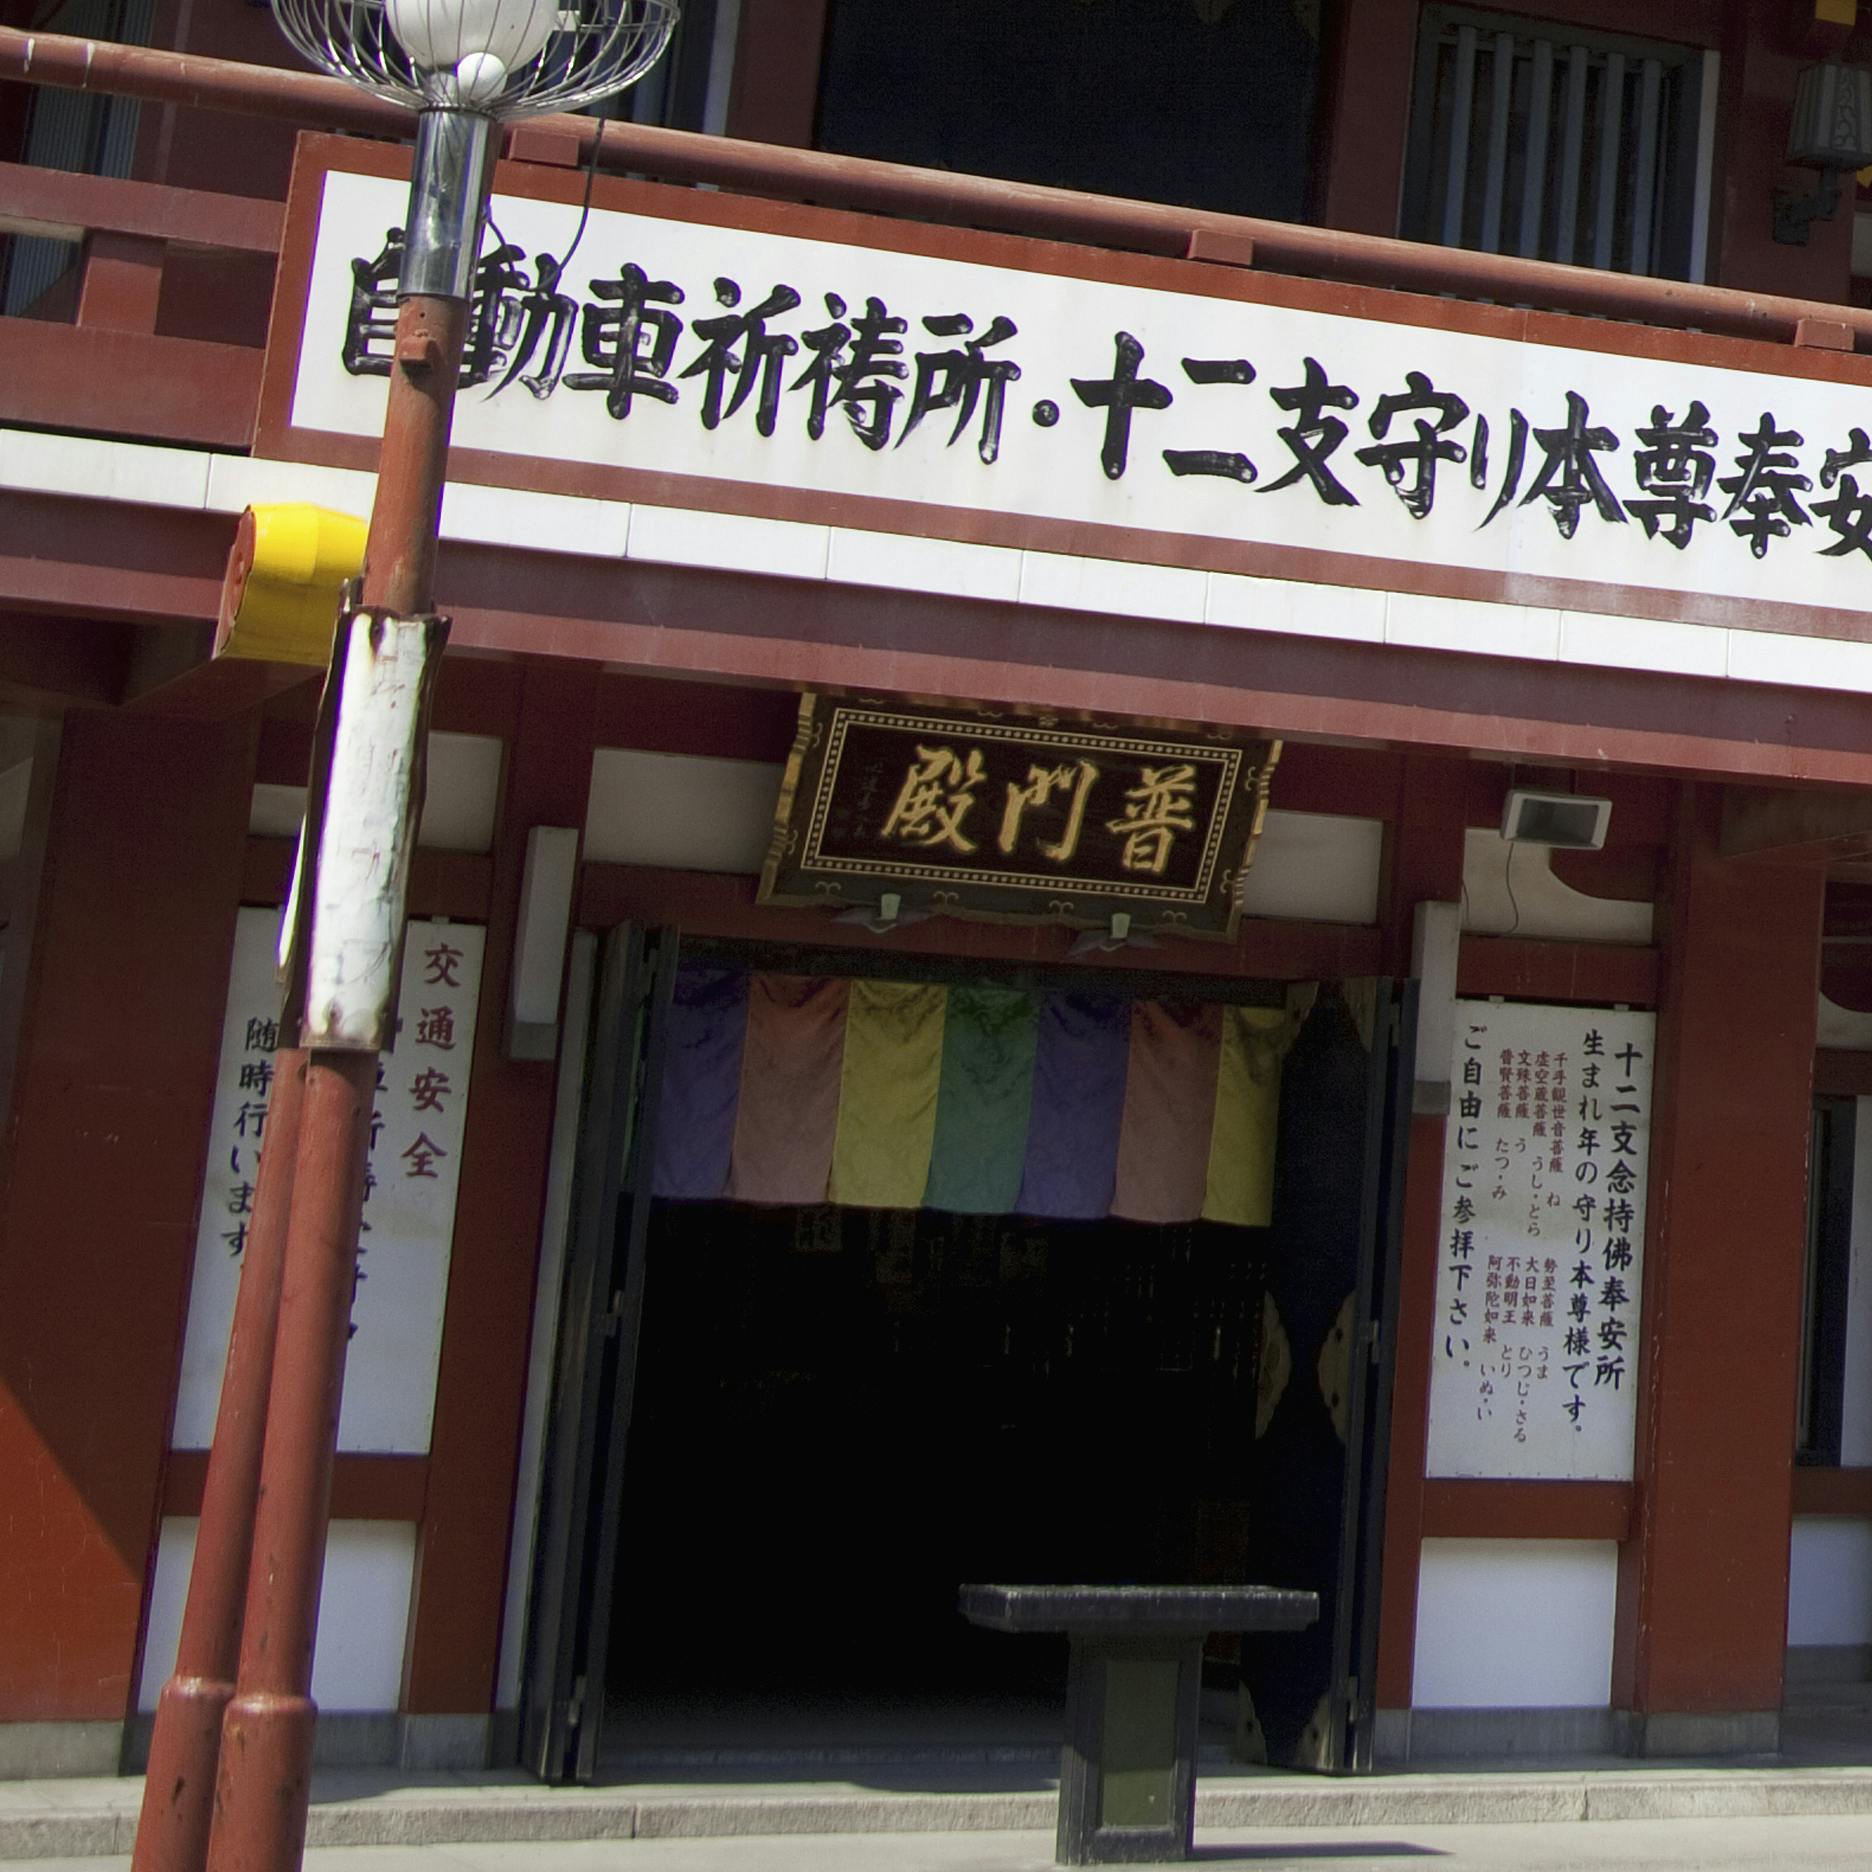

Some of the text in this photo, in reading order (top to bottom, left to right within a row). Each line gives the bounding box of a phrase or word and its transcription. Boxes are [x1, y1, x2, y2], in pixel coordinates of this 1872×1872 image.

[880, 743, 1198, 874] 普門殿
[400, 942, 464, 1179] 交通安全
[1514, 1049, 1532, 1153] 文殊菩薩 う
[1445, 1024, 1488, 1368] ご自由にご参拝下さい。
[1546, 1191, 1561, 1207] ね
[1562, 1028, 1605, 1432] 生まれ年の守り本尊様です。
[1593, 1042, 1643, 1391] 十二支念持佛奉安所
[1482, 1254, 1503, 1344] 阿弥陀如来
[1500, 1256, 1520, 1378] 不動明王 とり
[1521, 1256, 1538, 1327] 大日如来
[1536, 1346, 1550, 1380] うま
